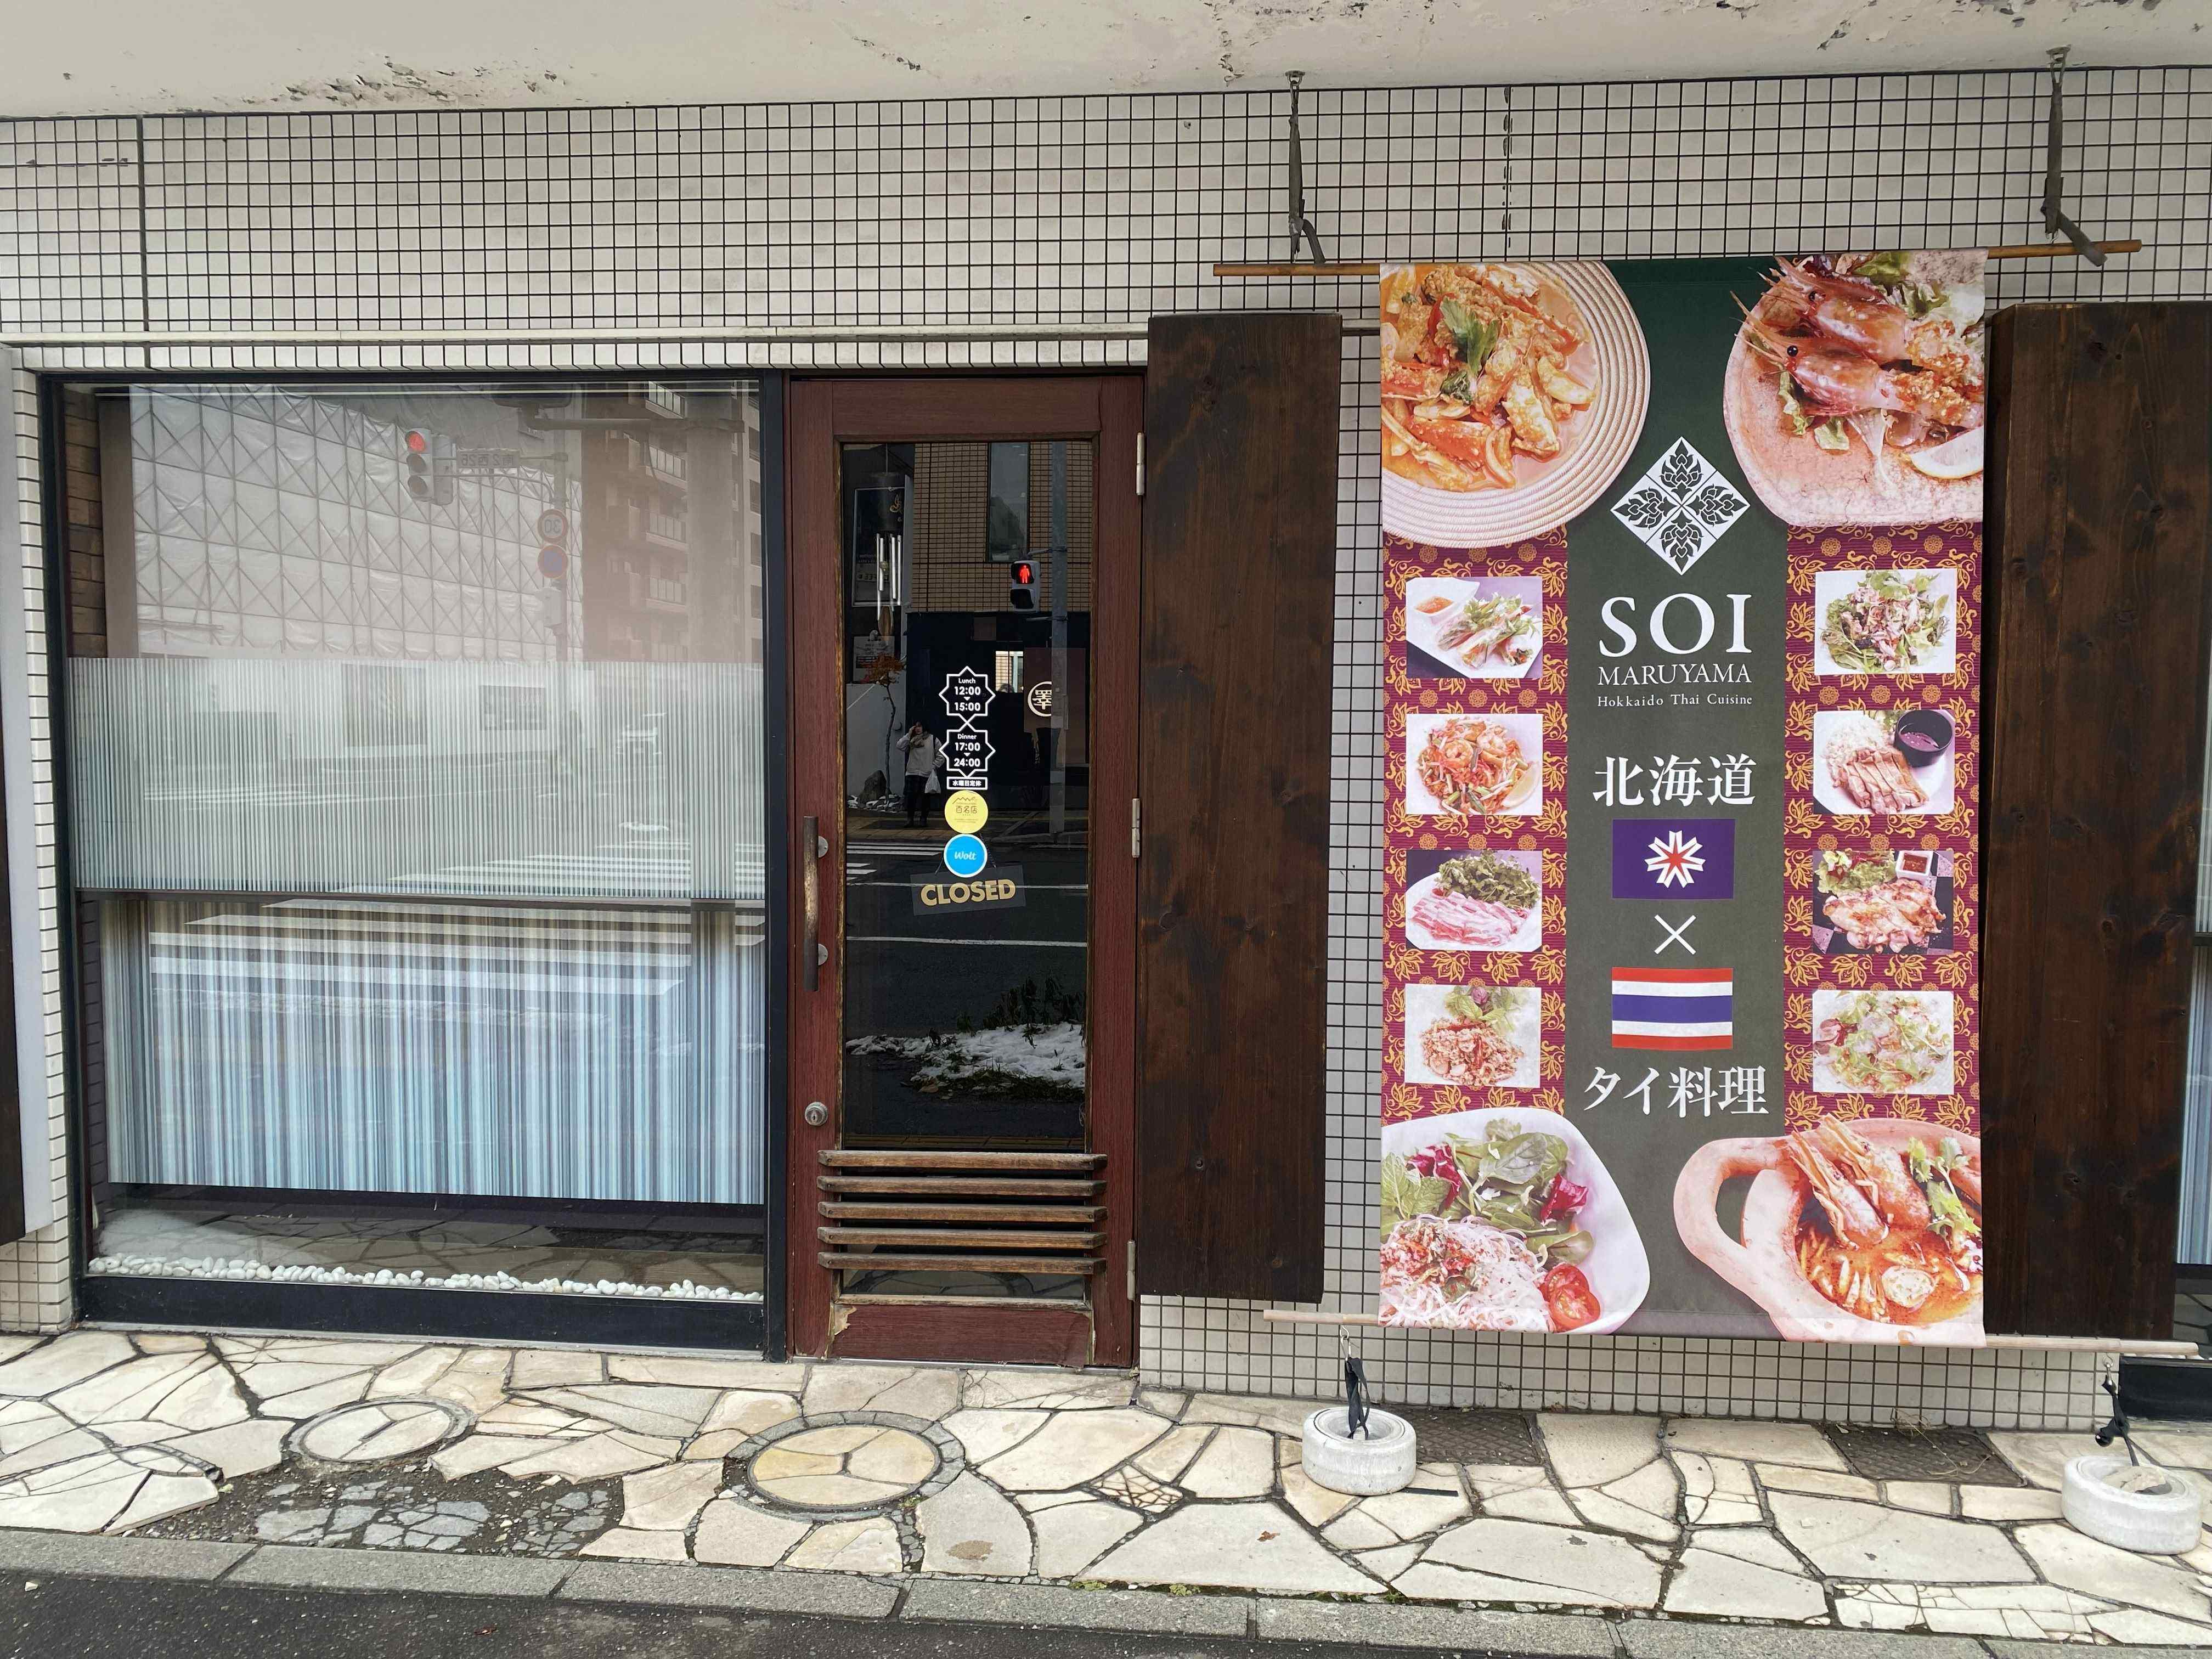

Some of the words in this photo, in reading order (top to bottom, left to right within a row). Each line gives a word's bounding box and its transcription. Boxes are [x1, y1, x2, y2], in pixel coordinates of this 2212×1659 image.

[1599, 592, 1753, 657] SOI
[1597, 663, 1753, 686] MARUYAMA
[955, 686, 981, 695] 12:00
[955, 702, 981, 711] 15:00
[1597, 694, 1664, 708] Hokkaido
[1671, 693, 1700, 706] Thai
[1707, 693, 1753, 705] Cuisine
[955, 742, 981, 751] 17:00
[953, 758, 981, 767] 24:00
[1592, 753, 1757, 807] 北海道
[956, 805, 978, 814] 百名店
[954, 851, 977, 860] Wolt
[920, 879, 1017, 906] CLOSED
[1583, 1065, 1769, 1119] タイ料理
